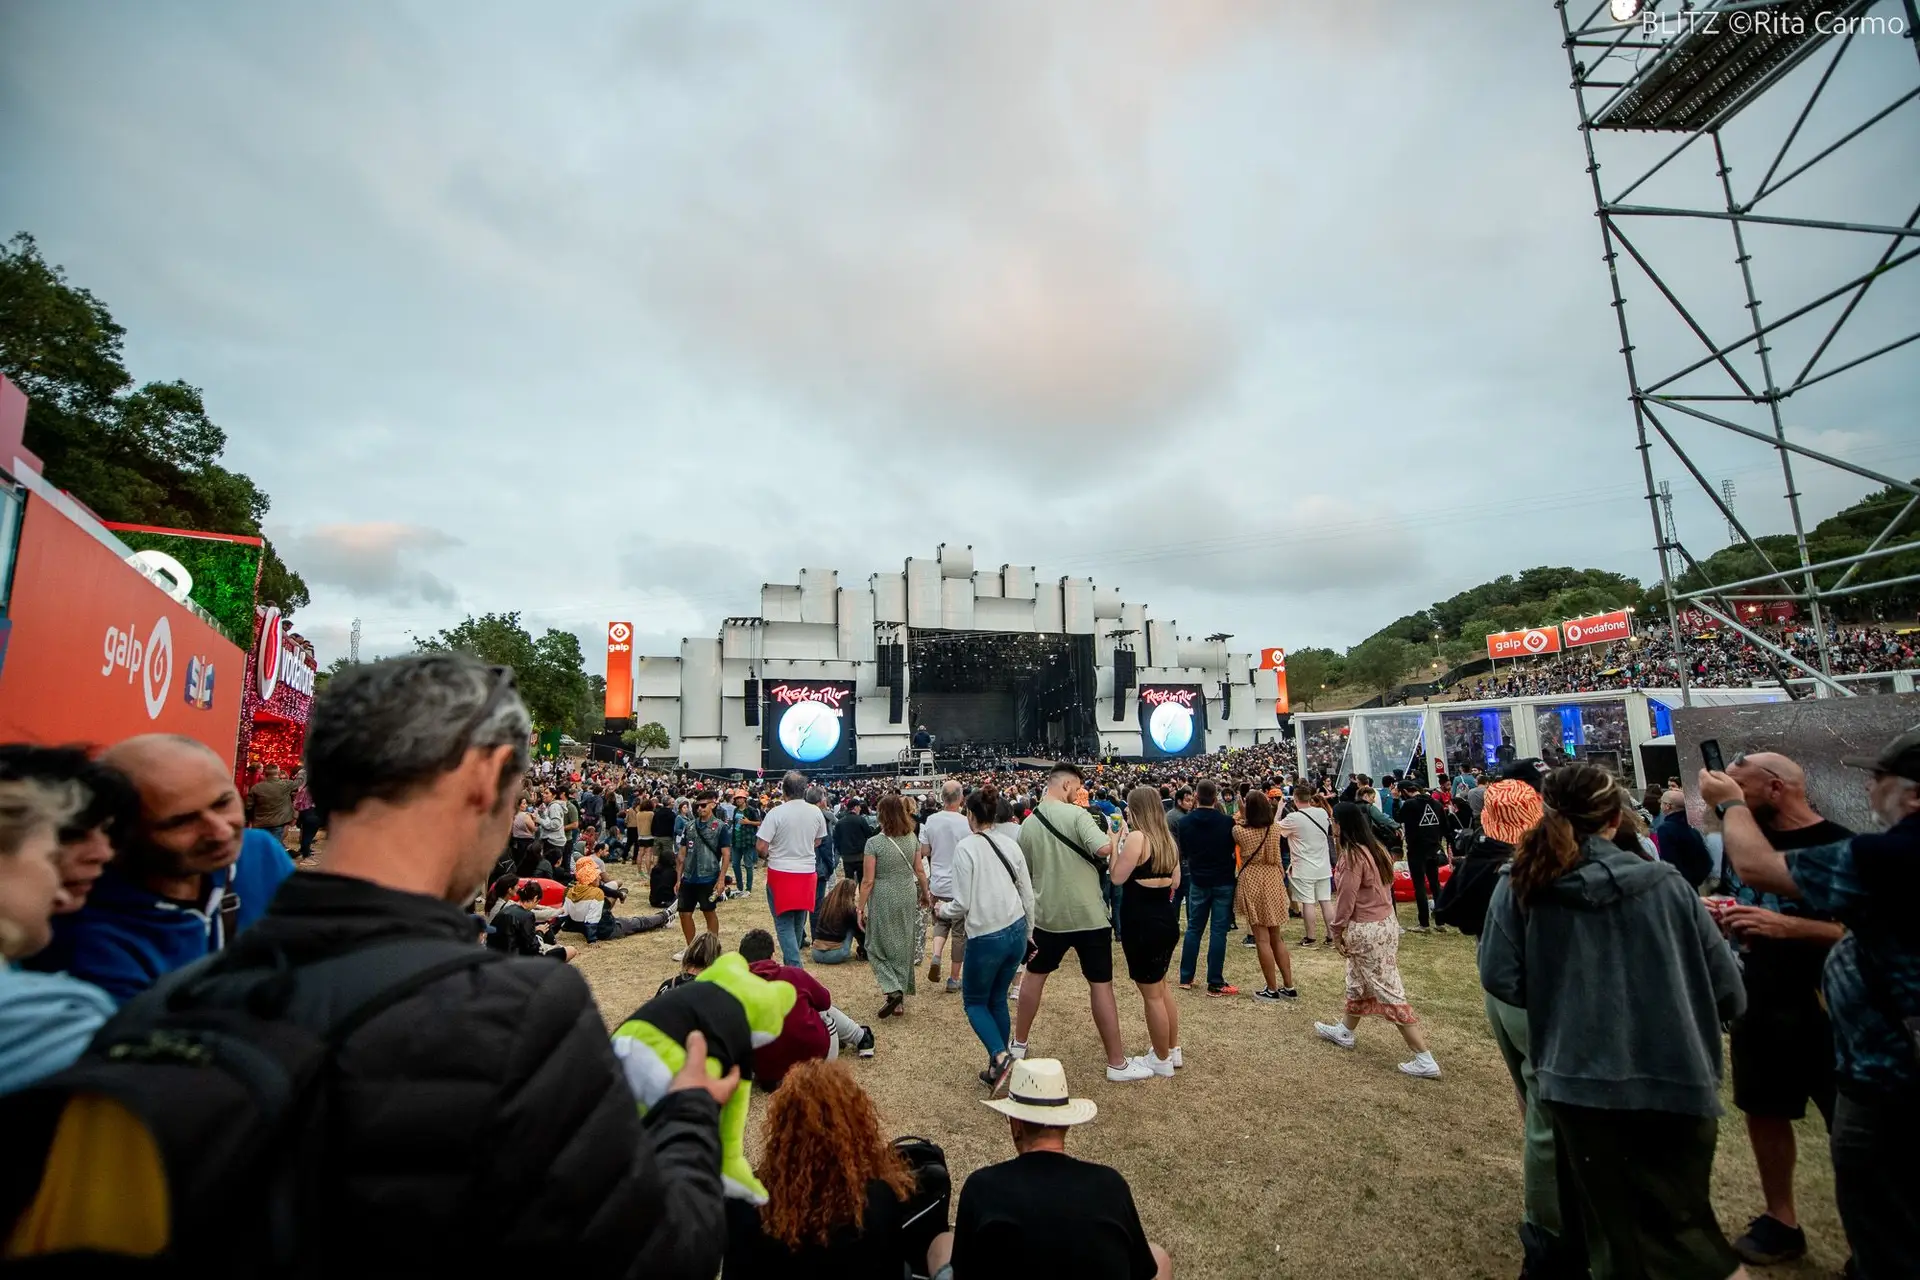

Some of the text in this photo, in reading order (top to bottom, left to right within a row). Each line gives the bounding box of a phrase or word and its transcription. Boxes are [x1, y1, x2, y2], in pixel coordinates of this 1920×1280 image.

[1582, 621, 1626, 635] vodafone
[608, 643, 630, 653] galp
[1496, 639, 1521, 652] galp
[101, 623, 143, 685] galp
[771, 685, 849, 707] Rock in Rio
[1142, 689, 1170, 706] Rock
[1176, 690, 1197, 707] Rio
